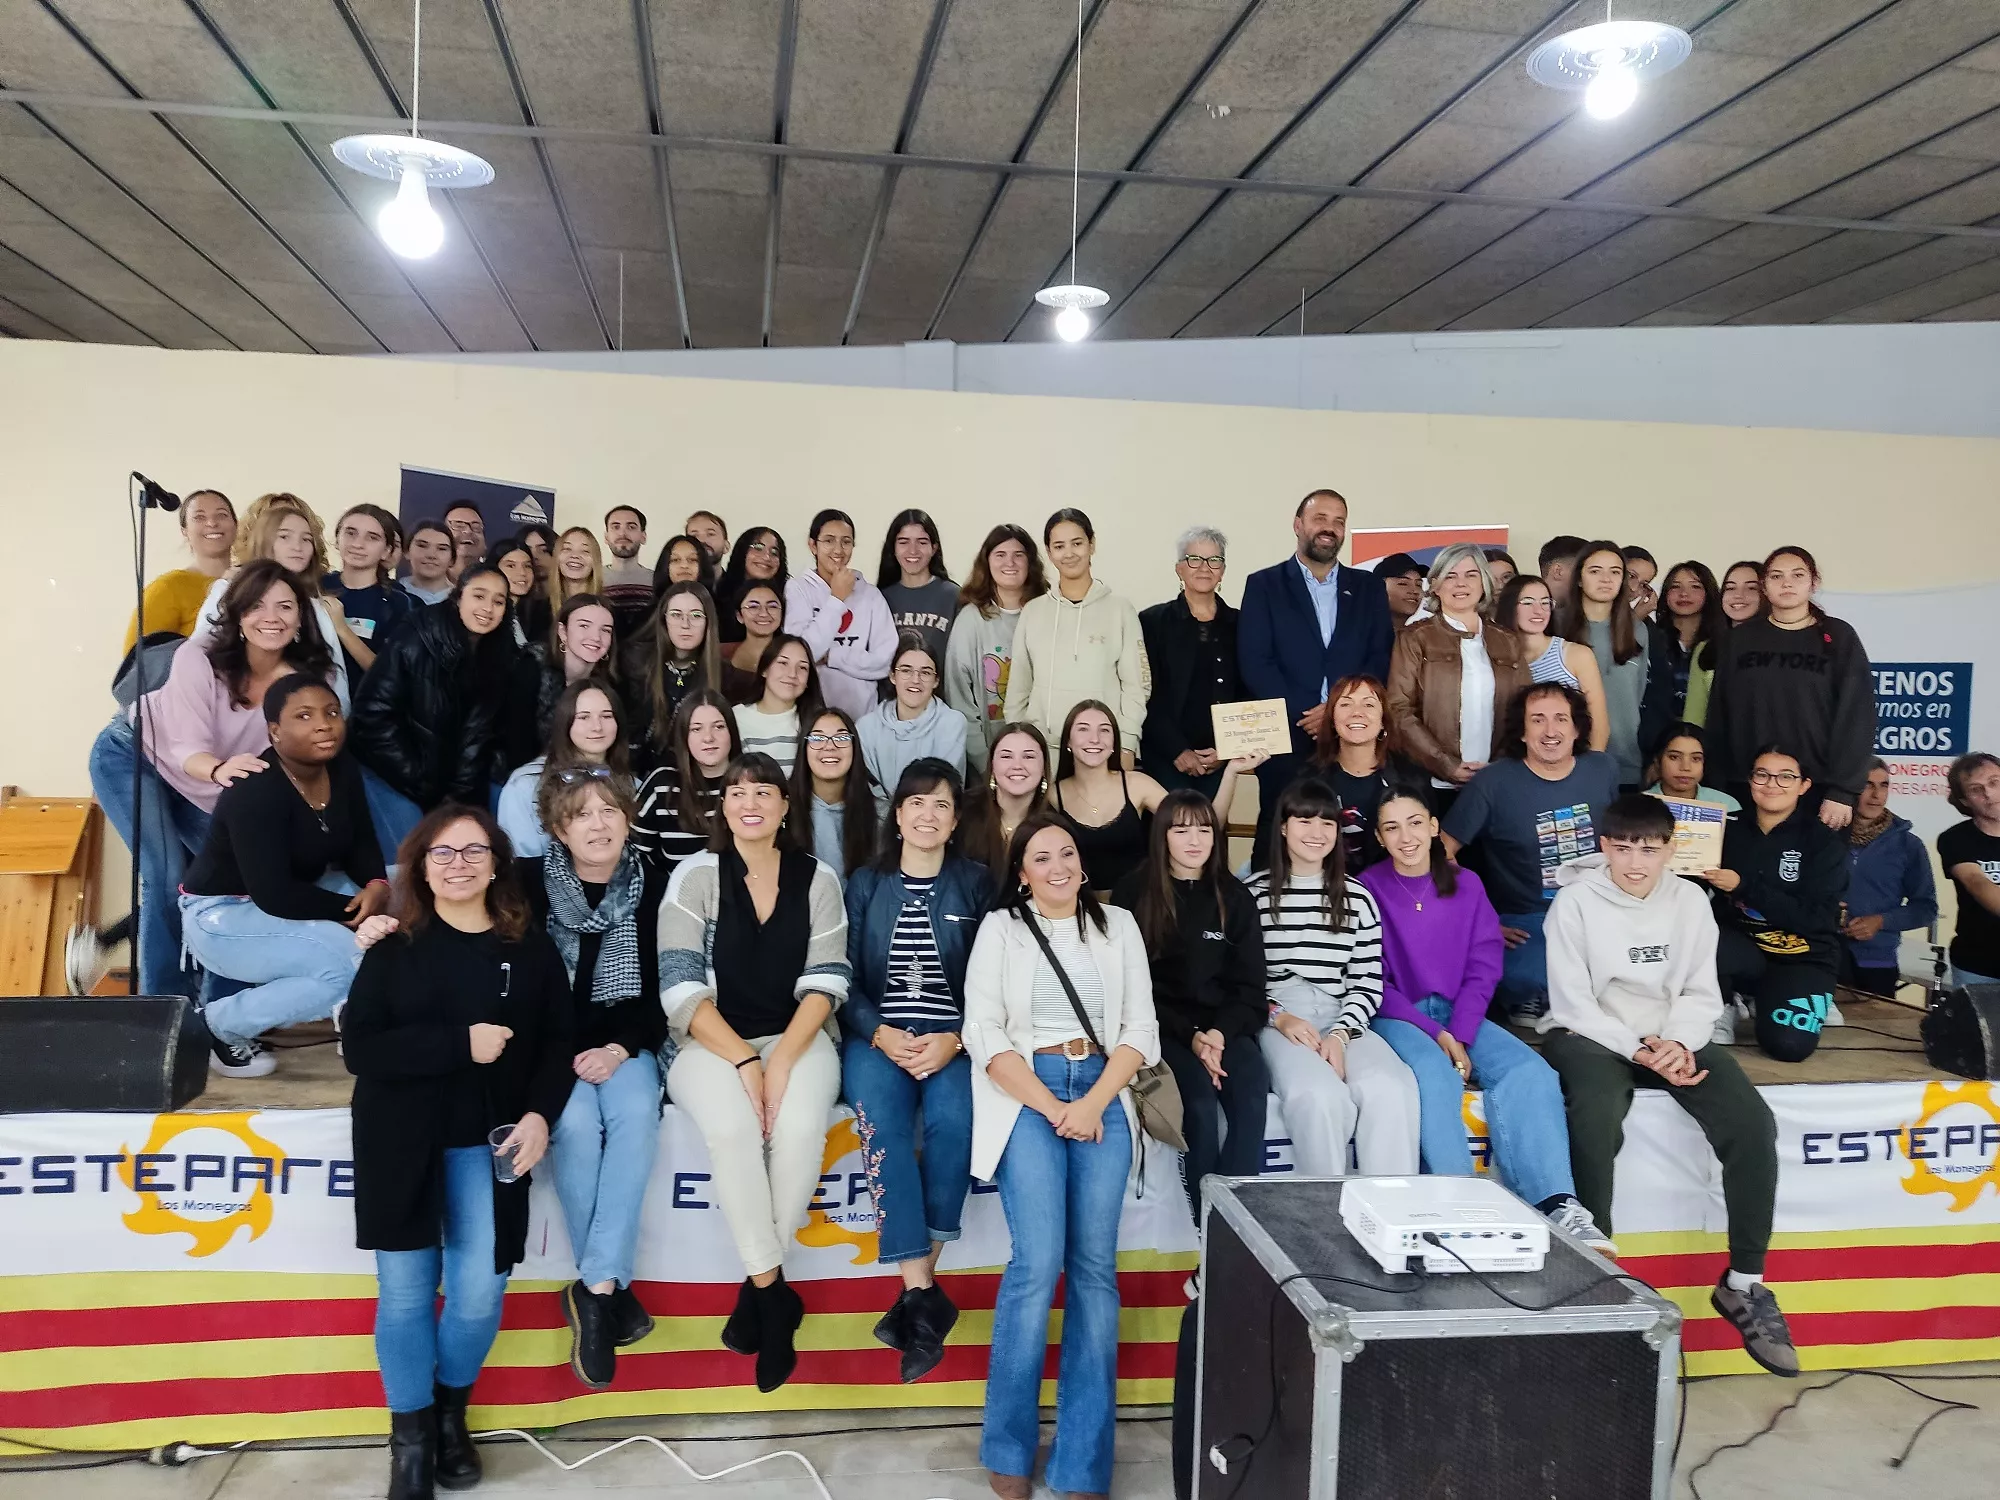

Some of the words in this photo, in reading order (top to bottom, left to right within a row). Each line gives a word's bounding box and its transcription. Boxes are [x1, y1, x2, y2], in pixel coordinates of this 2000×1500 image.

[1735, 651, 1775, 672] NEW
[1776, 651, 1829, 676] YORK
[1926, 702, 1951, 718] en
[1945, 1162, 1995, 1175] Monegros
[156, 1199, 179, 1211] Los
[182, 1199, 252, 1213] Monegros
[824, 1214, 843, 1223] Los
